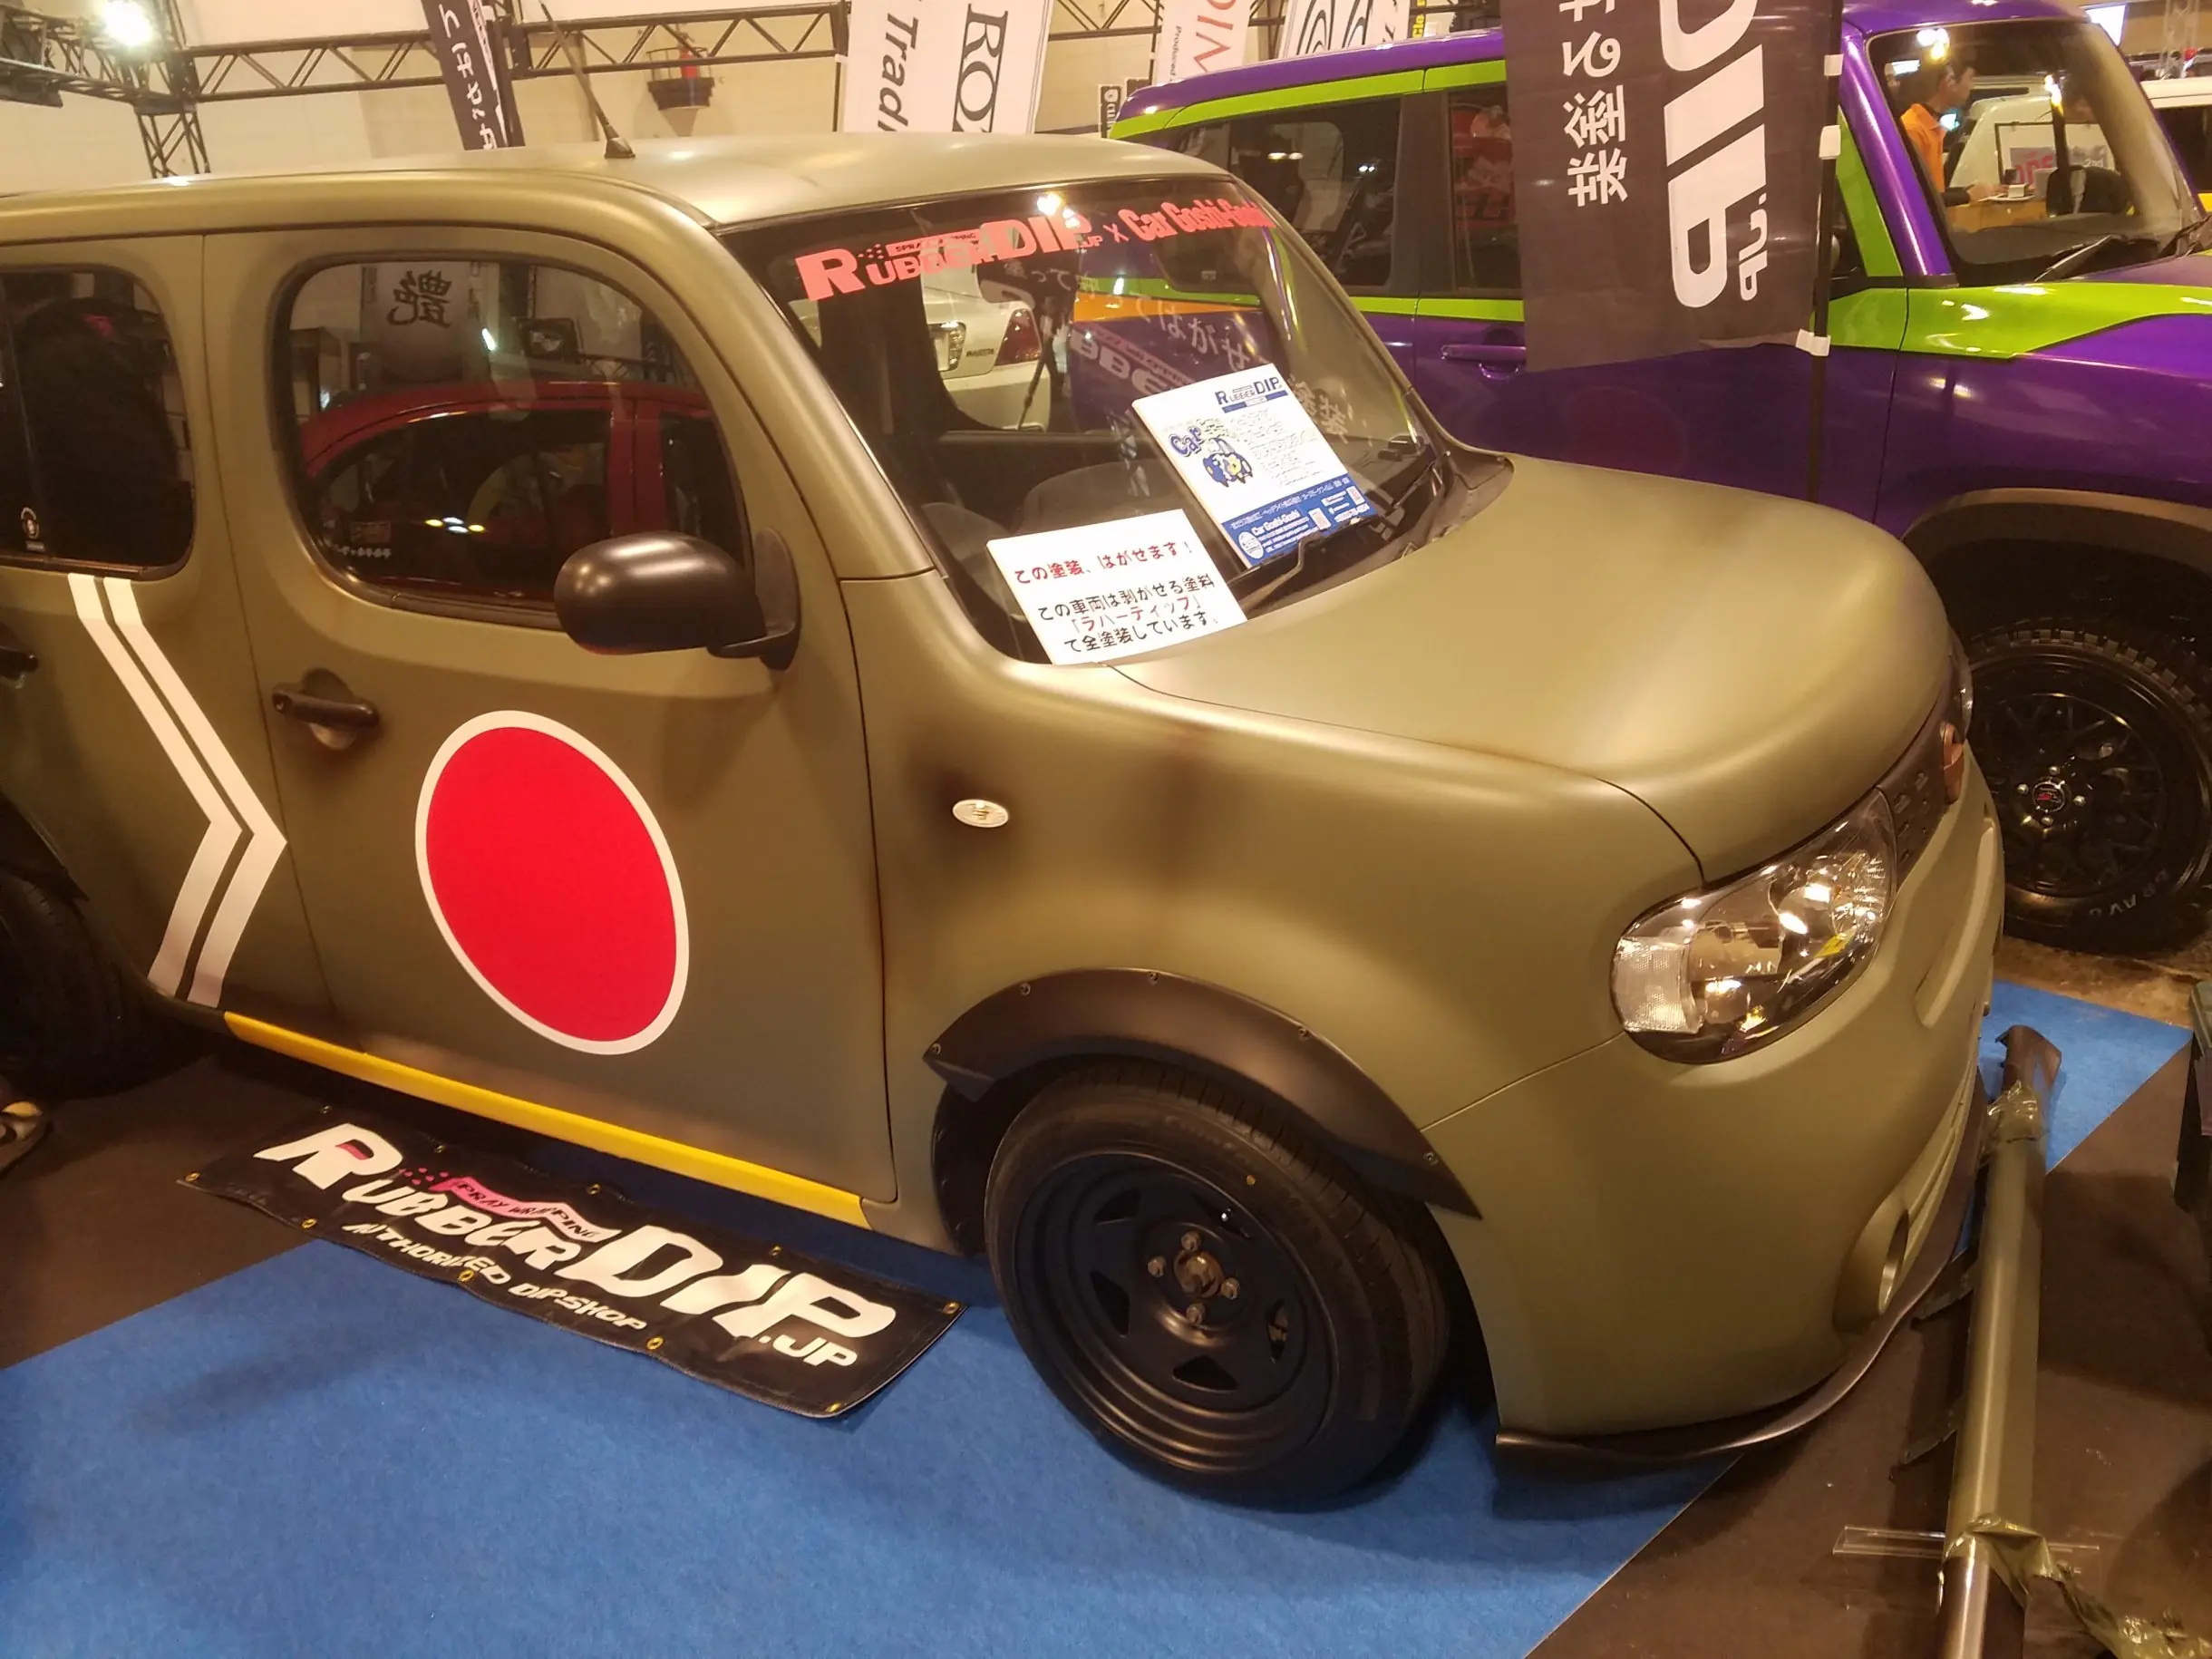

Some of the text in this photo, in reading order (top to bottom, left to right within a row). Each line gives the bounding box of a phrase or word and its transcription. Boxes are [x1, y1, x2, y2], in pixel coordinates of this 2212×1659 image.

[952, 4, 1008, 132] RO
[1118, 209, 1178, 242] Car
[453, 1181, 509, 1208] PRAY
[508, 1283, 647, 1330] DIPSHOP
